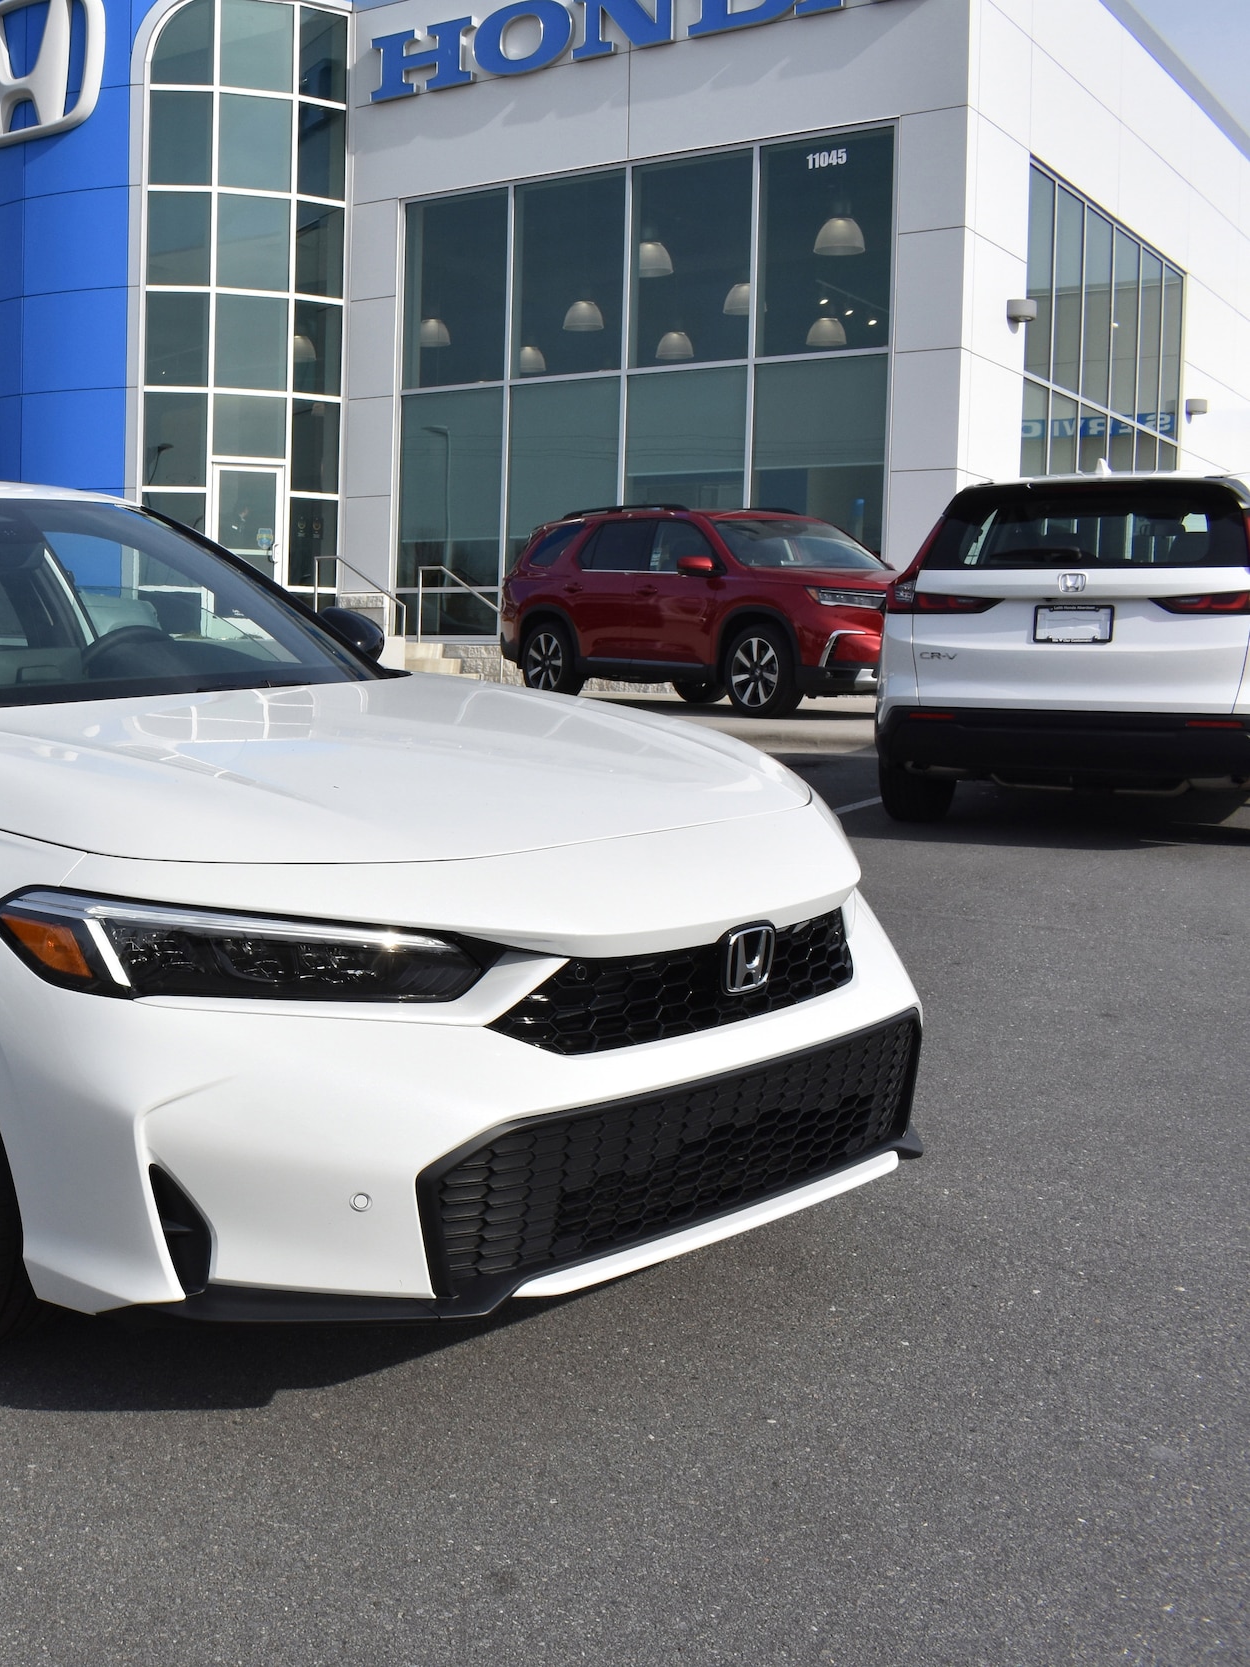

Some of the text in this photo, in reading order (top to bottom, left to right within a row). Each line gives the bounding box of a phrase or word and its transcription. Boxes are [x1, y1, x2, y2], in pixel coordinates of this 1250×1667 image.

[370, 0, 844, 102] HON
[806, 148, 847, 170] 11045
[920, 651, 957, 660] CR-V
